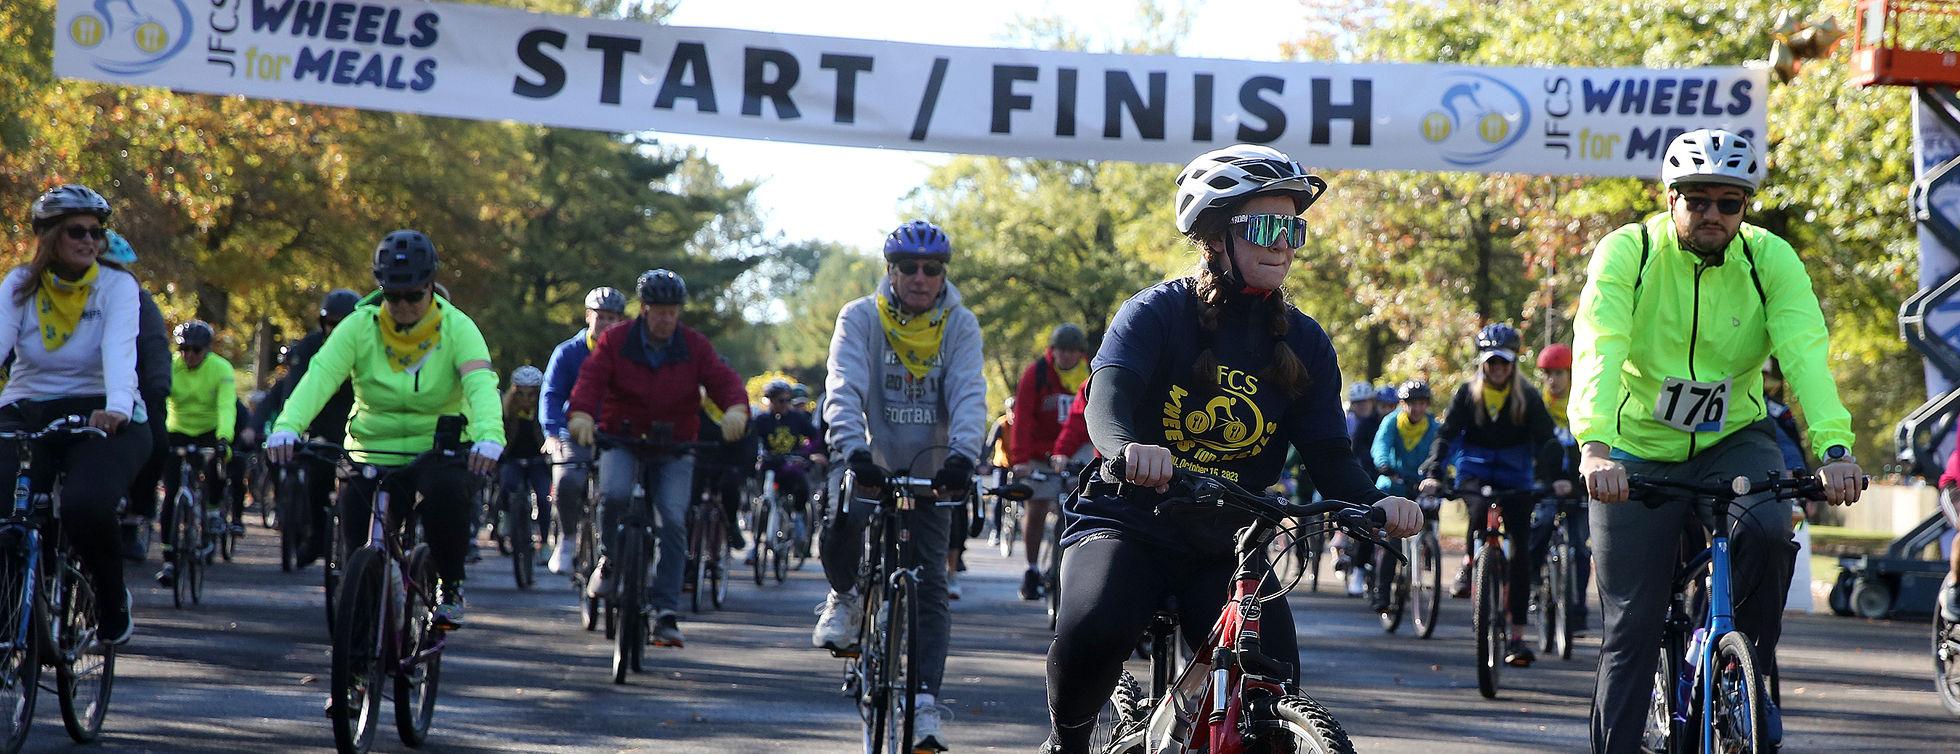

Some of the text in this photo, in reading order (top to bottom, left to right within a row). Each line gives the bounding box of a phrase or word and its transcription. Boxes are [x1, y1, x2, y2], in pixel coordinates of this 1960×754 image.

[251, 0, 440, 48] WHEELS
[246, 46, 437, 92] for MEALS
[512, 28, 1372, 146] START / FINISH
[1544, 77, 1571, 158] JFCS
[1582, 78, 1752, 115] WHEELS
[1579, 127, 1620, 159] for
[1216, 365, 1259, 395] FCS
[1664, 383, 1726, 426] 176
